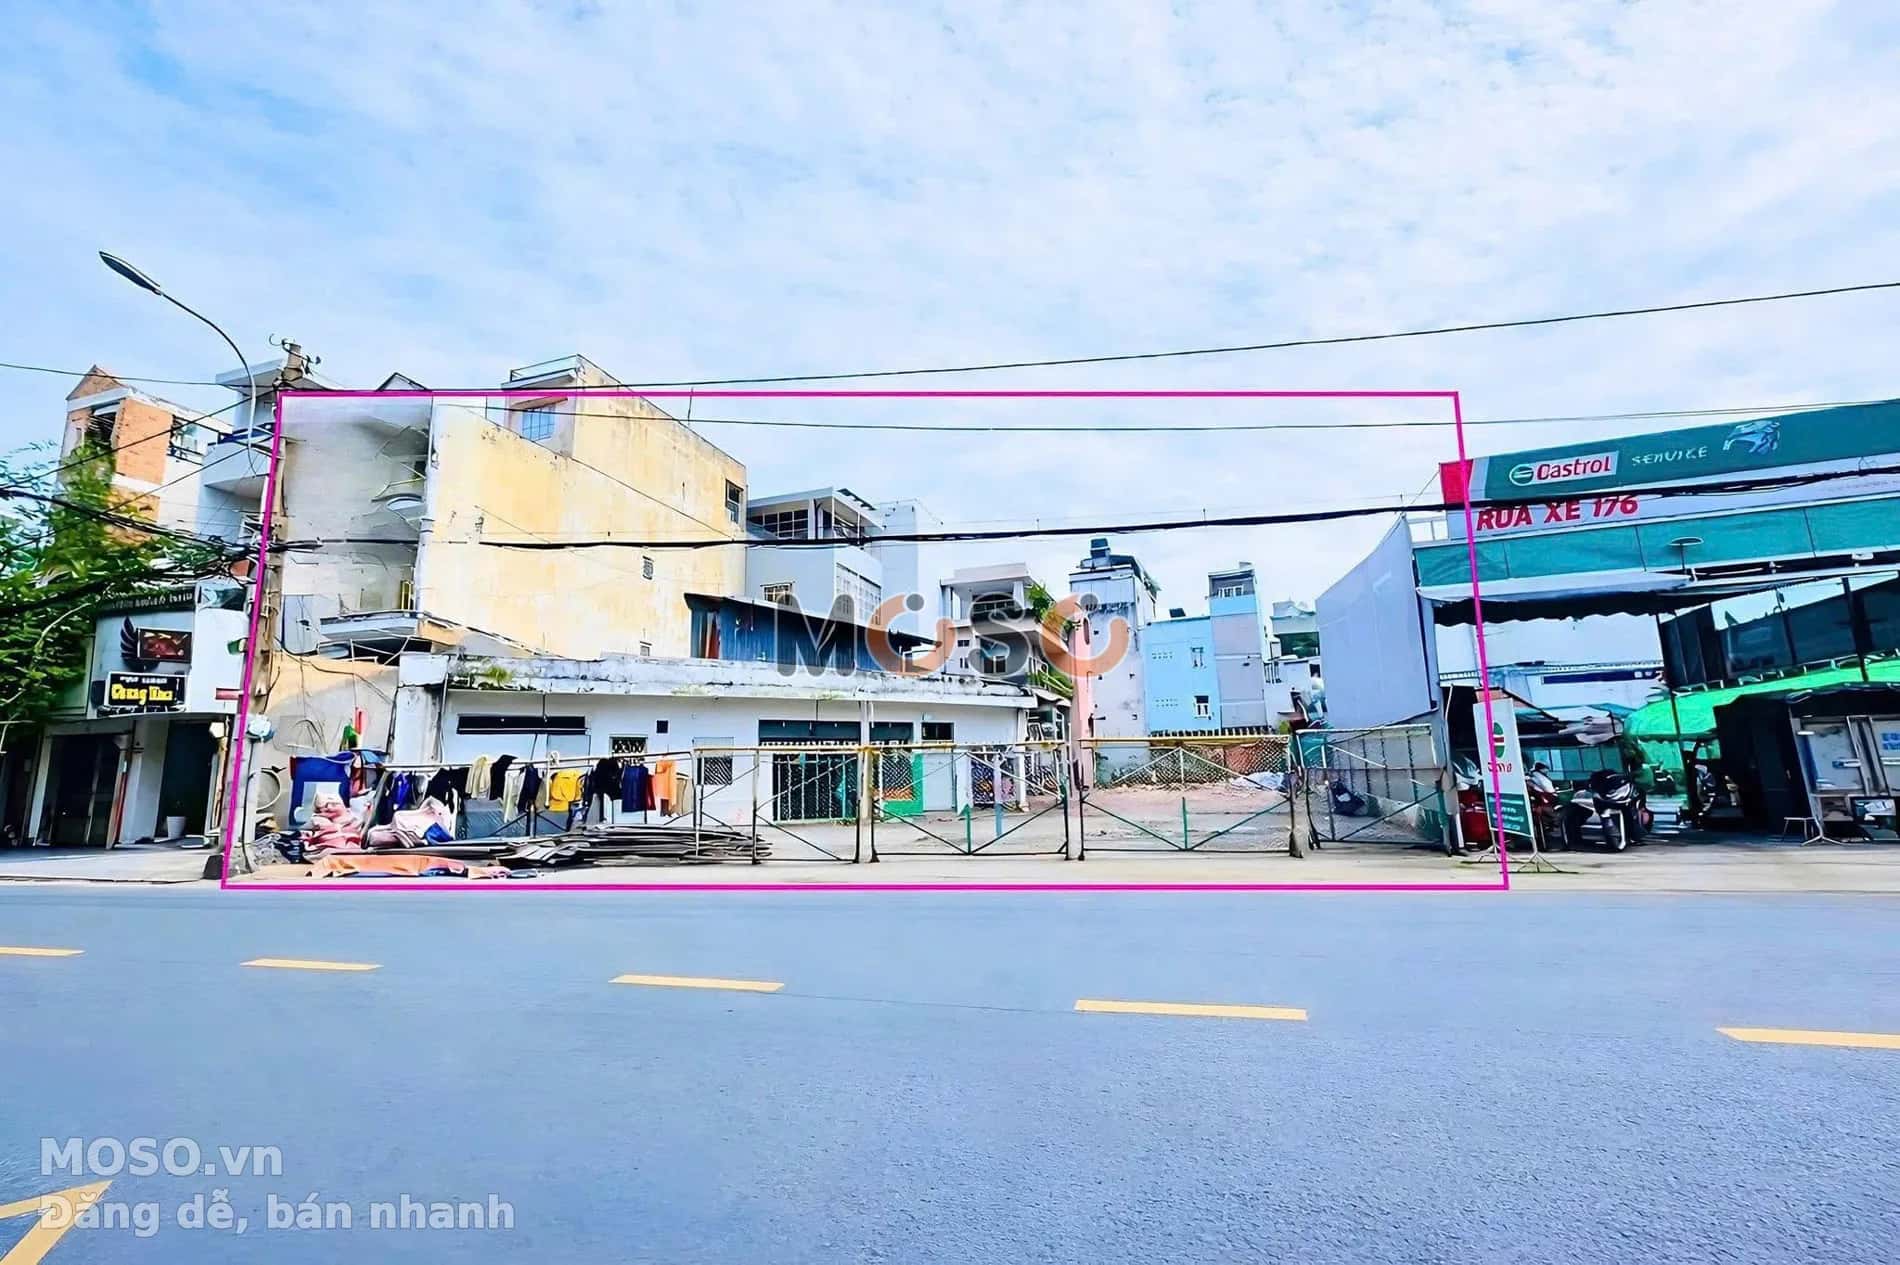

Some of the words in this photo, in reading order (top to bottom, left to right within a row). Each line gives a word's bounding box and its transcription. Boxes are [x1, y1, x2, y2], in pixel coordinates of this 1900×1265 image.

[1536, 456, 1612, 481] Castrol
[1543, 499, 1581, 524] XE
[1593, 494, 1639, 518] 176
